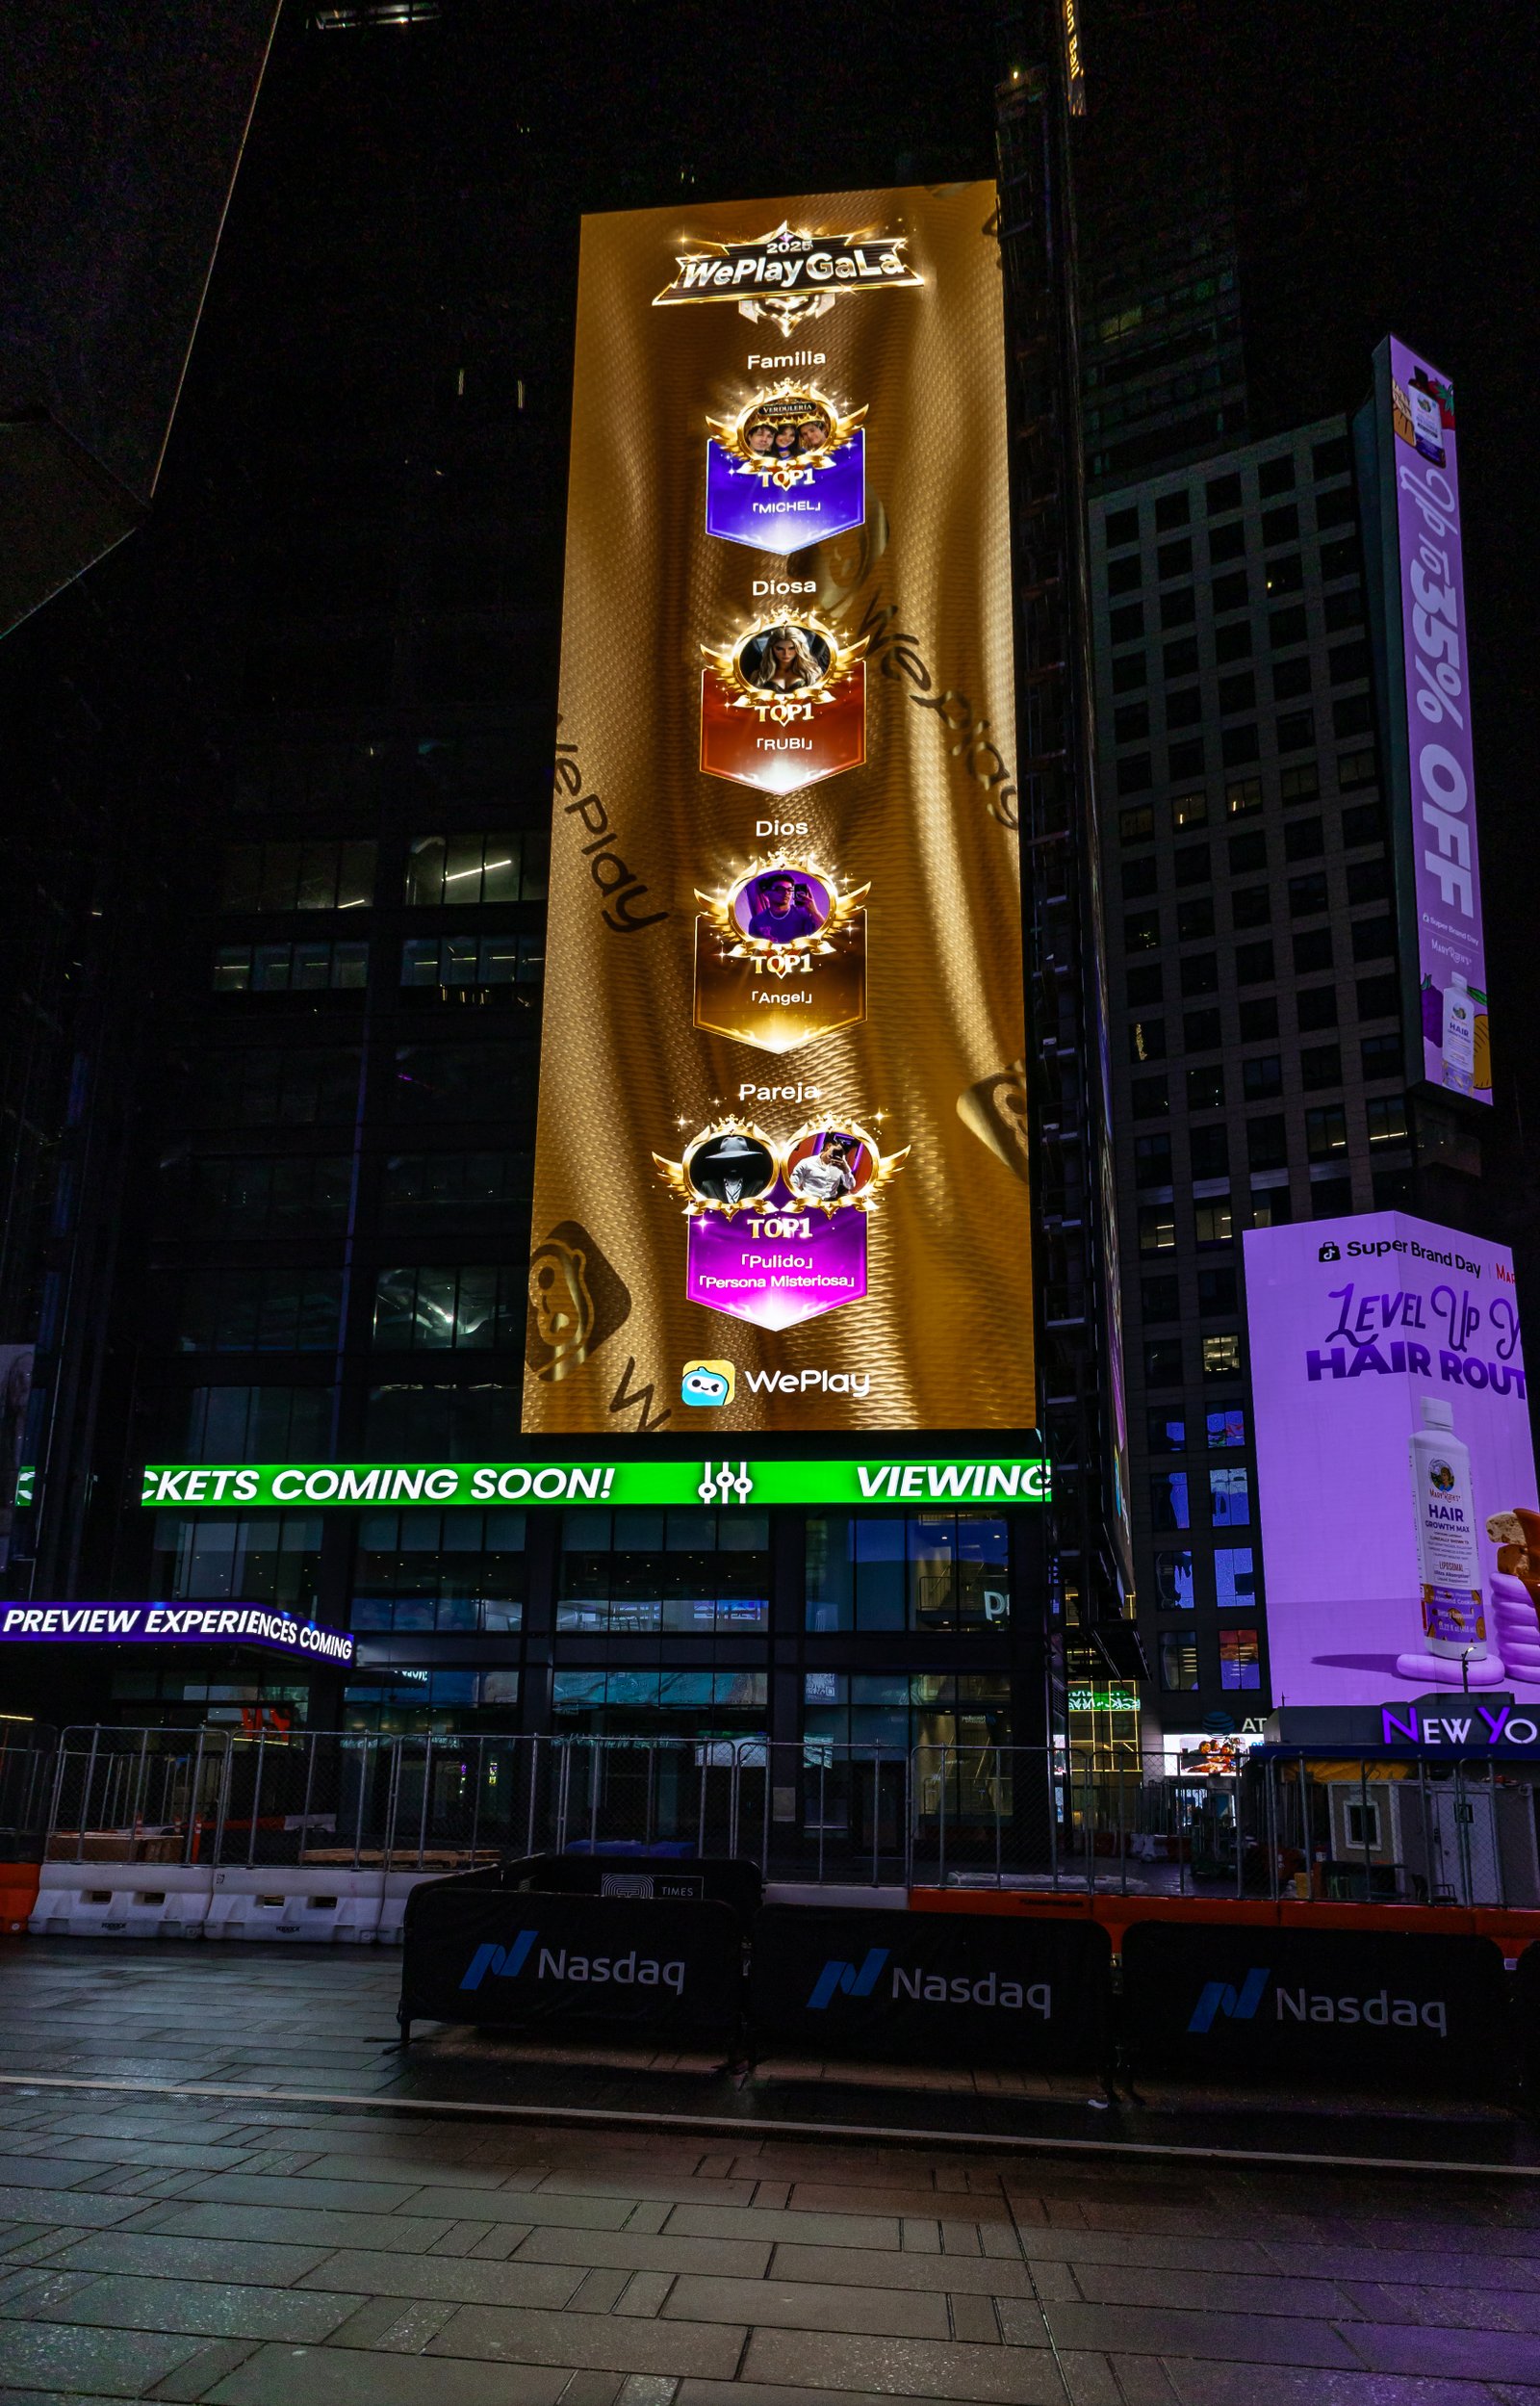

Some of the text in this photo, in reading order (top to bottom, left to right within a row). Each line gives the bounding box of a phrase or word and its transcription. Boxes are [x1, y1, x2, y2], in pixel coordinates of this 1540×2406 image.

[767, 241, 813, 254] 2025
[747, 350, 827, 370] Familia
[752, 579, 817, 597] Diosa
[1410, 558, 1464, 730] 35%
[553, 714, 671, 933] ePlay
[755, 819, 808, 837] Dios
[1419, 743, 1474, 918] OFF
[739, 1082, 819, 1104] Pareja
[747, 1217, 813, 1240] TOP1
[1347, 1239, 1408, 1258] Super
[1411, 1242, 1452, 1267] Brand
[1455, 1255, 1481, 1279] Day
[744, 1369, 871, 1398] WePlay
[1306, 1341, 1526, 1400] HAIR ROUT
[271, 1469, 459, 1501] COMING
[471, 1467, 616, 1501] SOON!
[857, 1463, 1051, 1497] VIEWING
[1424, 1520, 1470, 1533] GROWTH MAX
[1428, 1504, 1464, 1522] HAIR
[3, 1610, 352, 1661] PREVIEW EXPERIENCES COMING
[1381, 1706, 1472, 1745] NEW
[662, 1887, 693, 1897] TIMES
[538, 1949, 685, 1995] Nasdaq
[892, 1967, 1051, 2019] Nasdaq
[1276, 1987, 1447, 2037] Nasdaq
